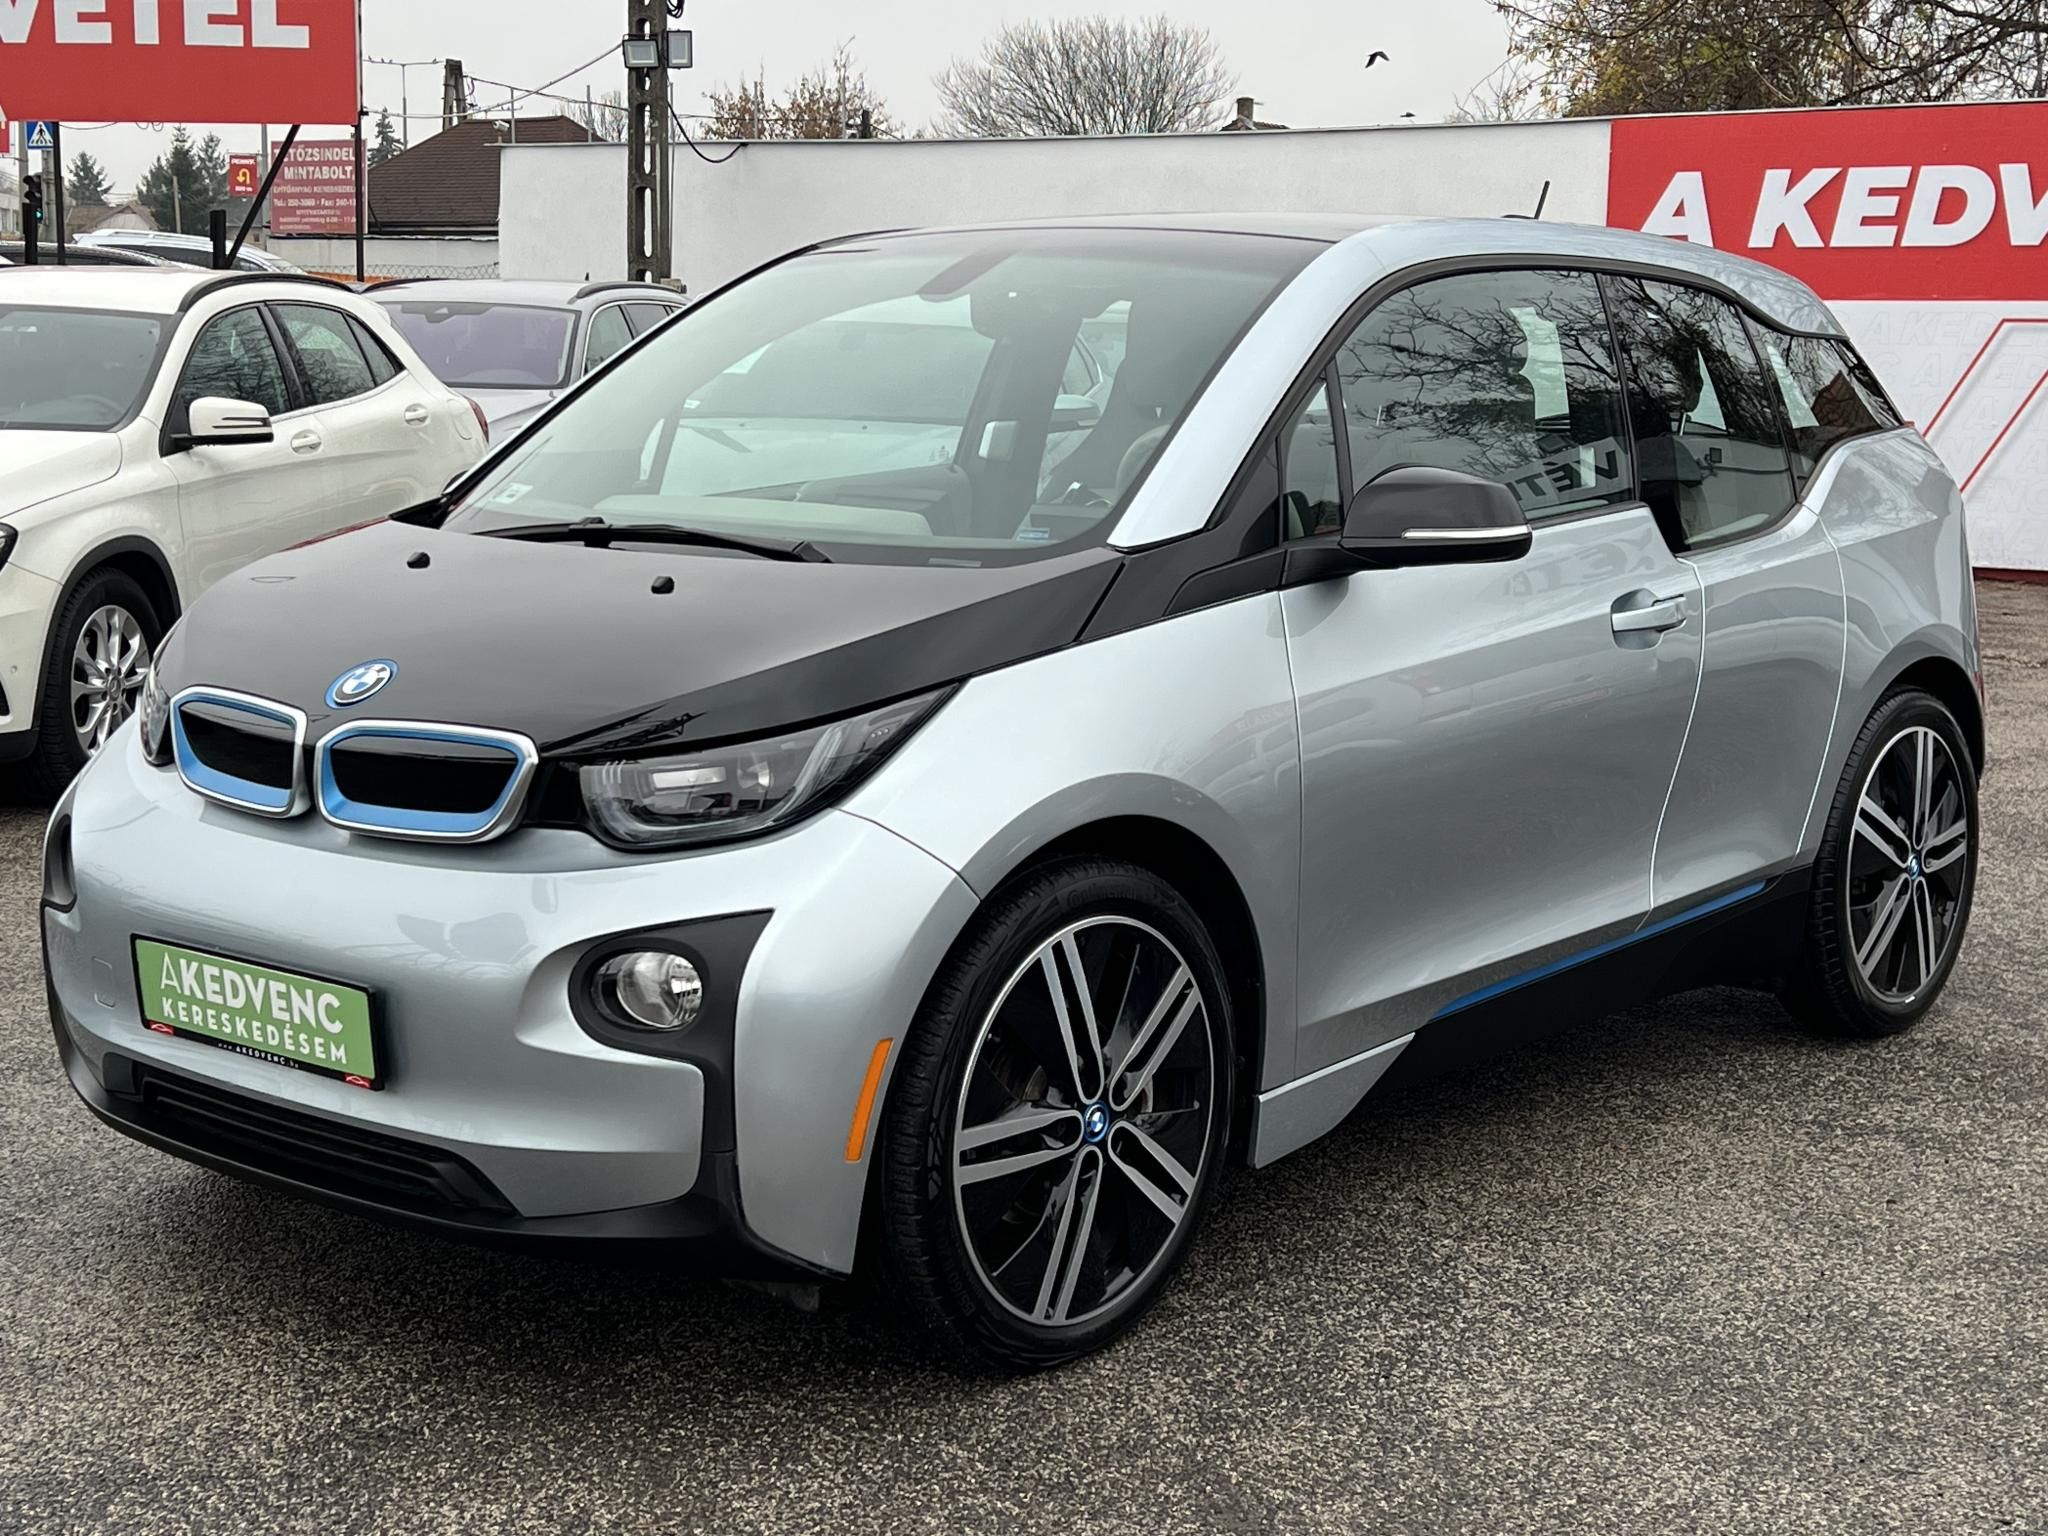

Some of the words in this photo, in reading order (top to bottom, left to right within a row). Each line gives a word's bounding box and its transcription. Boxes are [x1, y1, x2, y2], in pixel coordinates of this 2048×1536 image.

[1640, 171, 1715, 247] A
[1747, 163, 2048, 248] KEDV
[161, 996, 348, 1065] KERESKEDÉSEM
